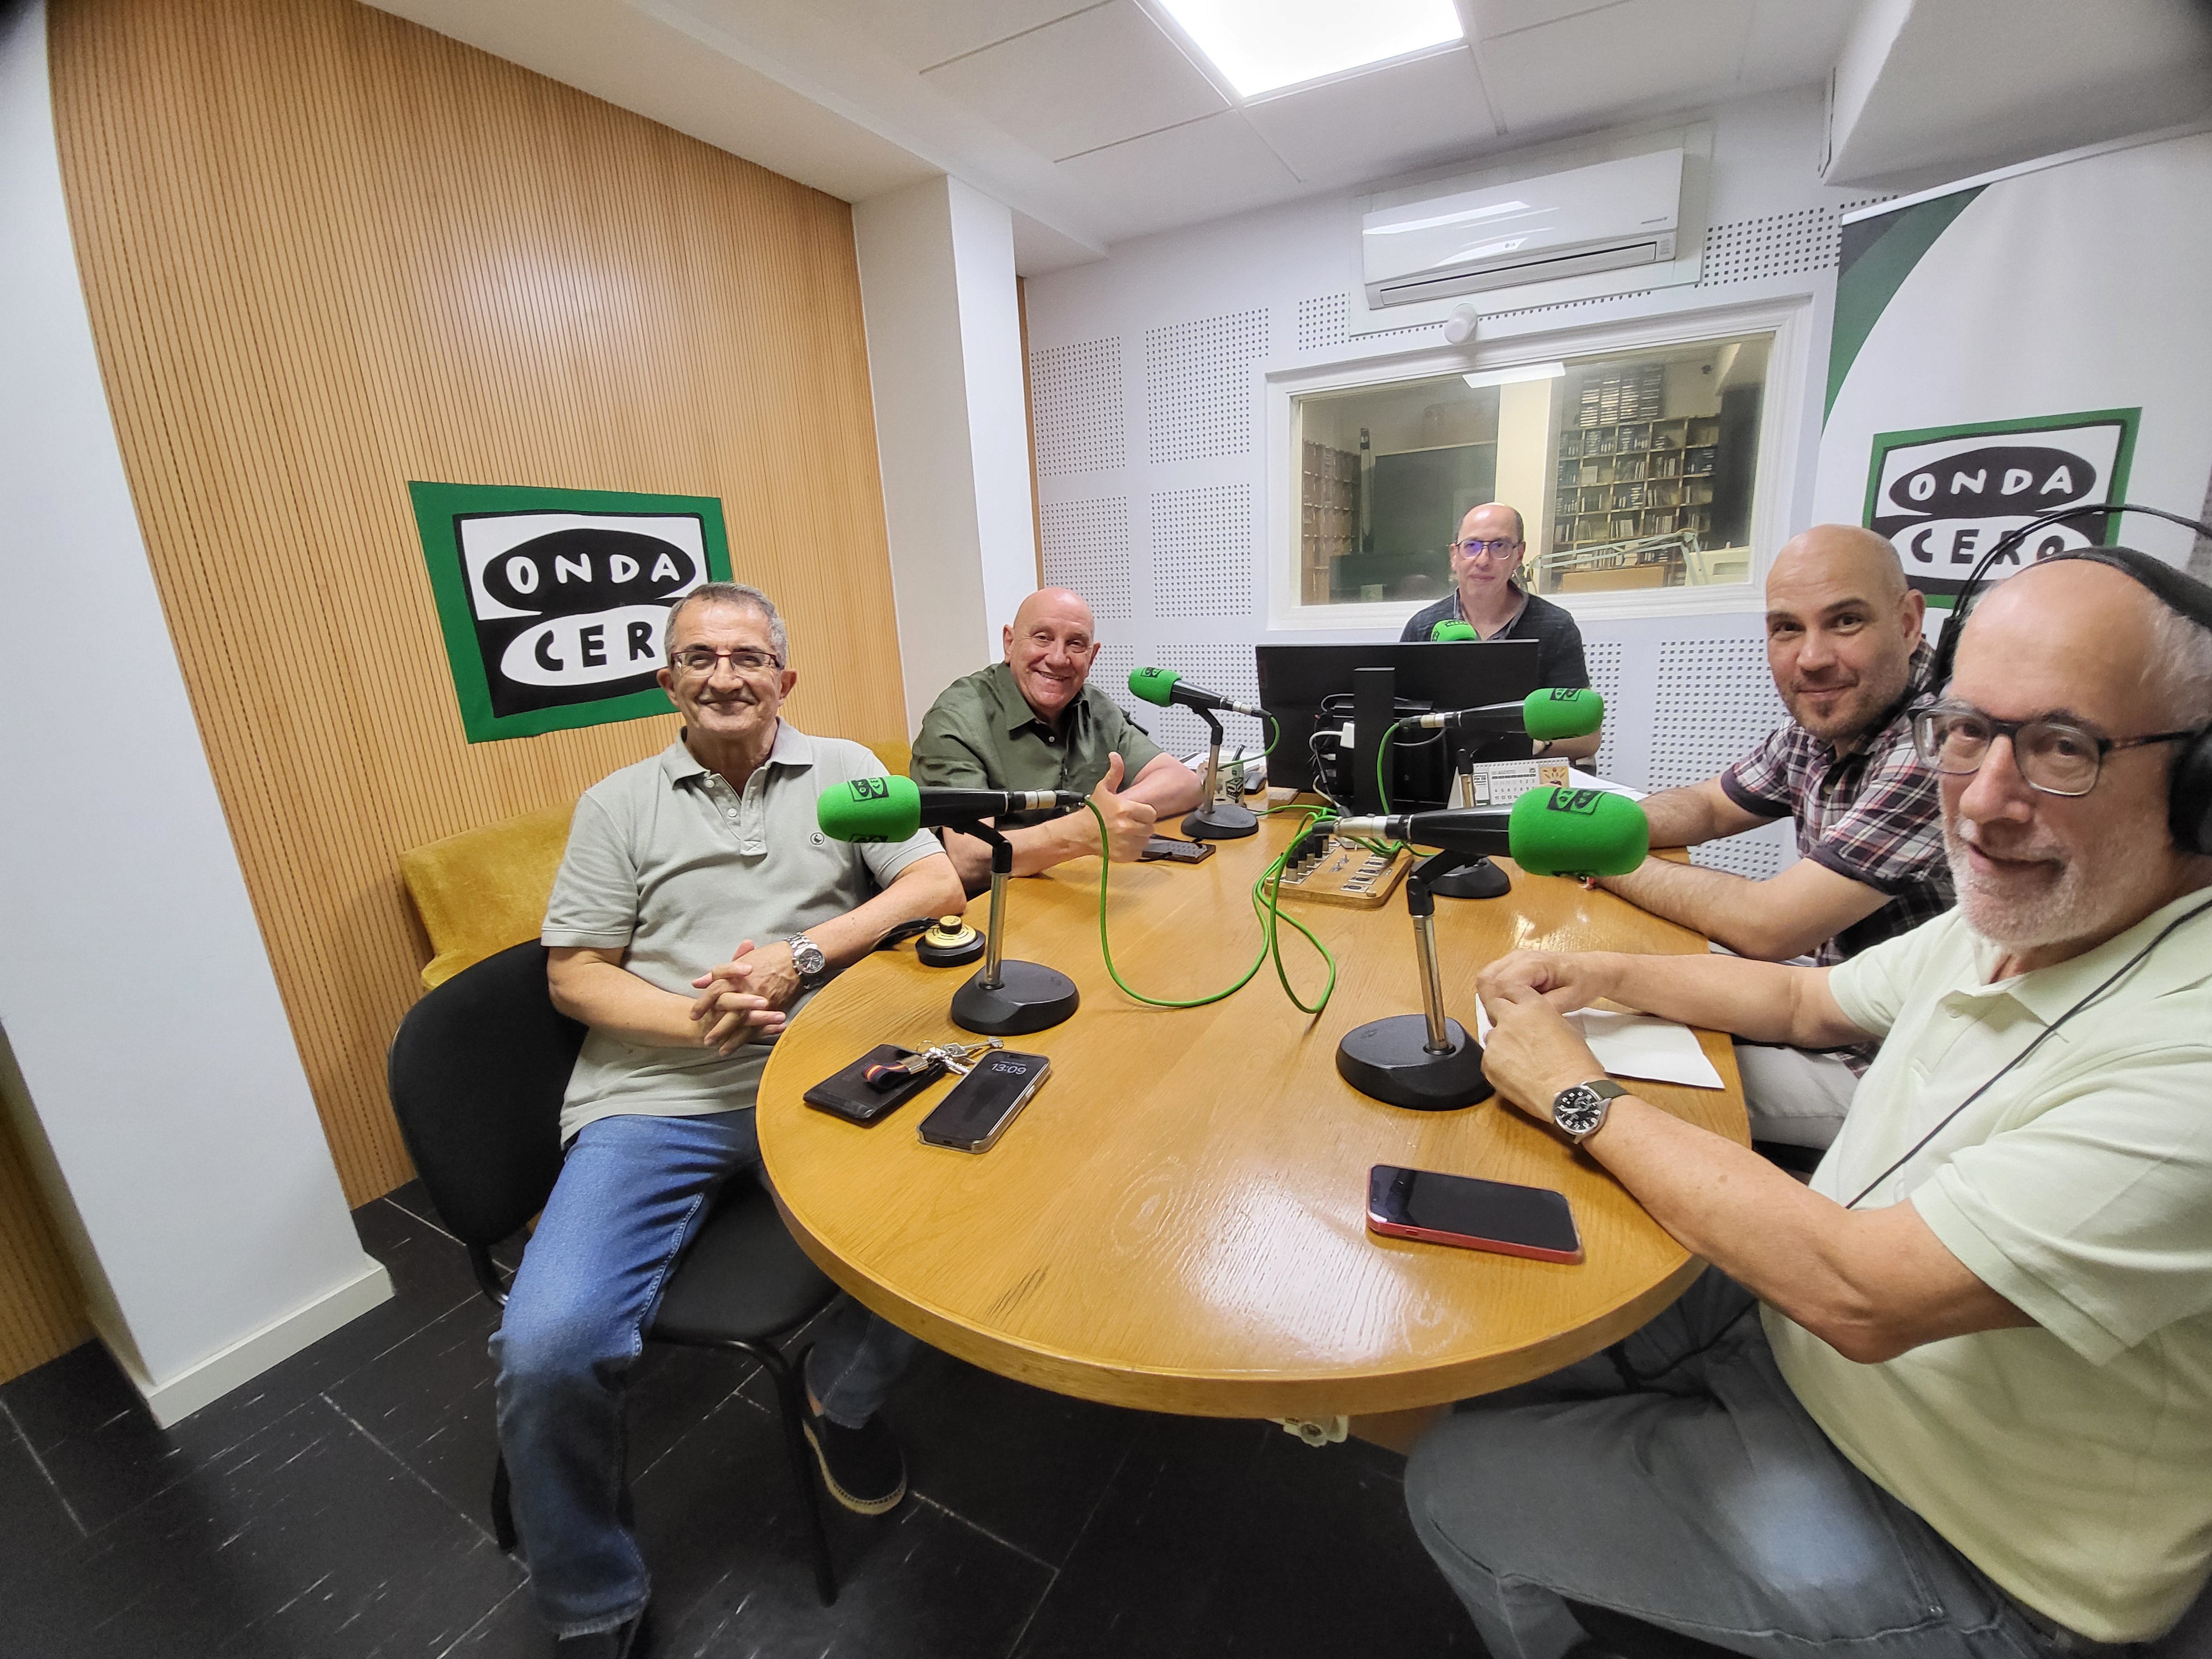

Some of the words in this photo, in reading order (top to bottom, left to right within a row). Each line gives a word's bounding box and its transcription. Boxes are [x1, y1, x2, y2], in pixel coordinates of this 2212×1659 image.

[1908, 465, 2073, 501] ONDA
[506, 553, 680, 594] ONDA
[534, 621, 656, 672] CER
[991, 1063, 1027, 1075] 13:09
